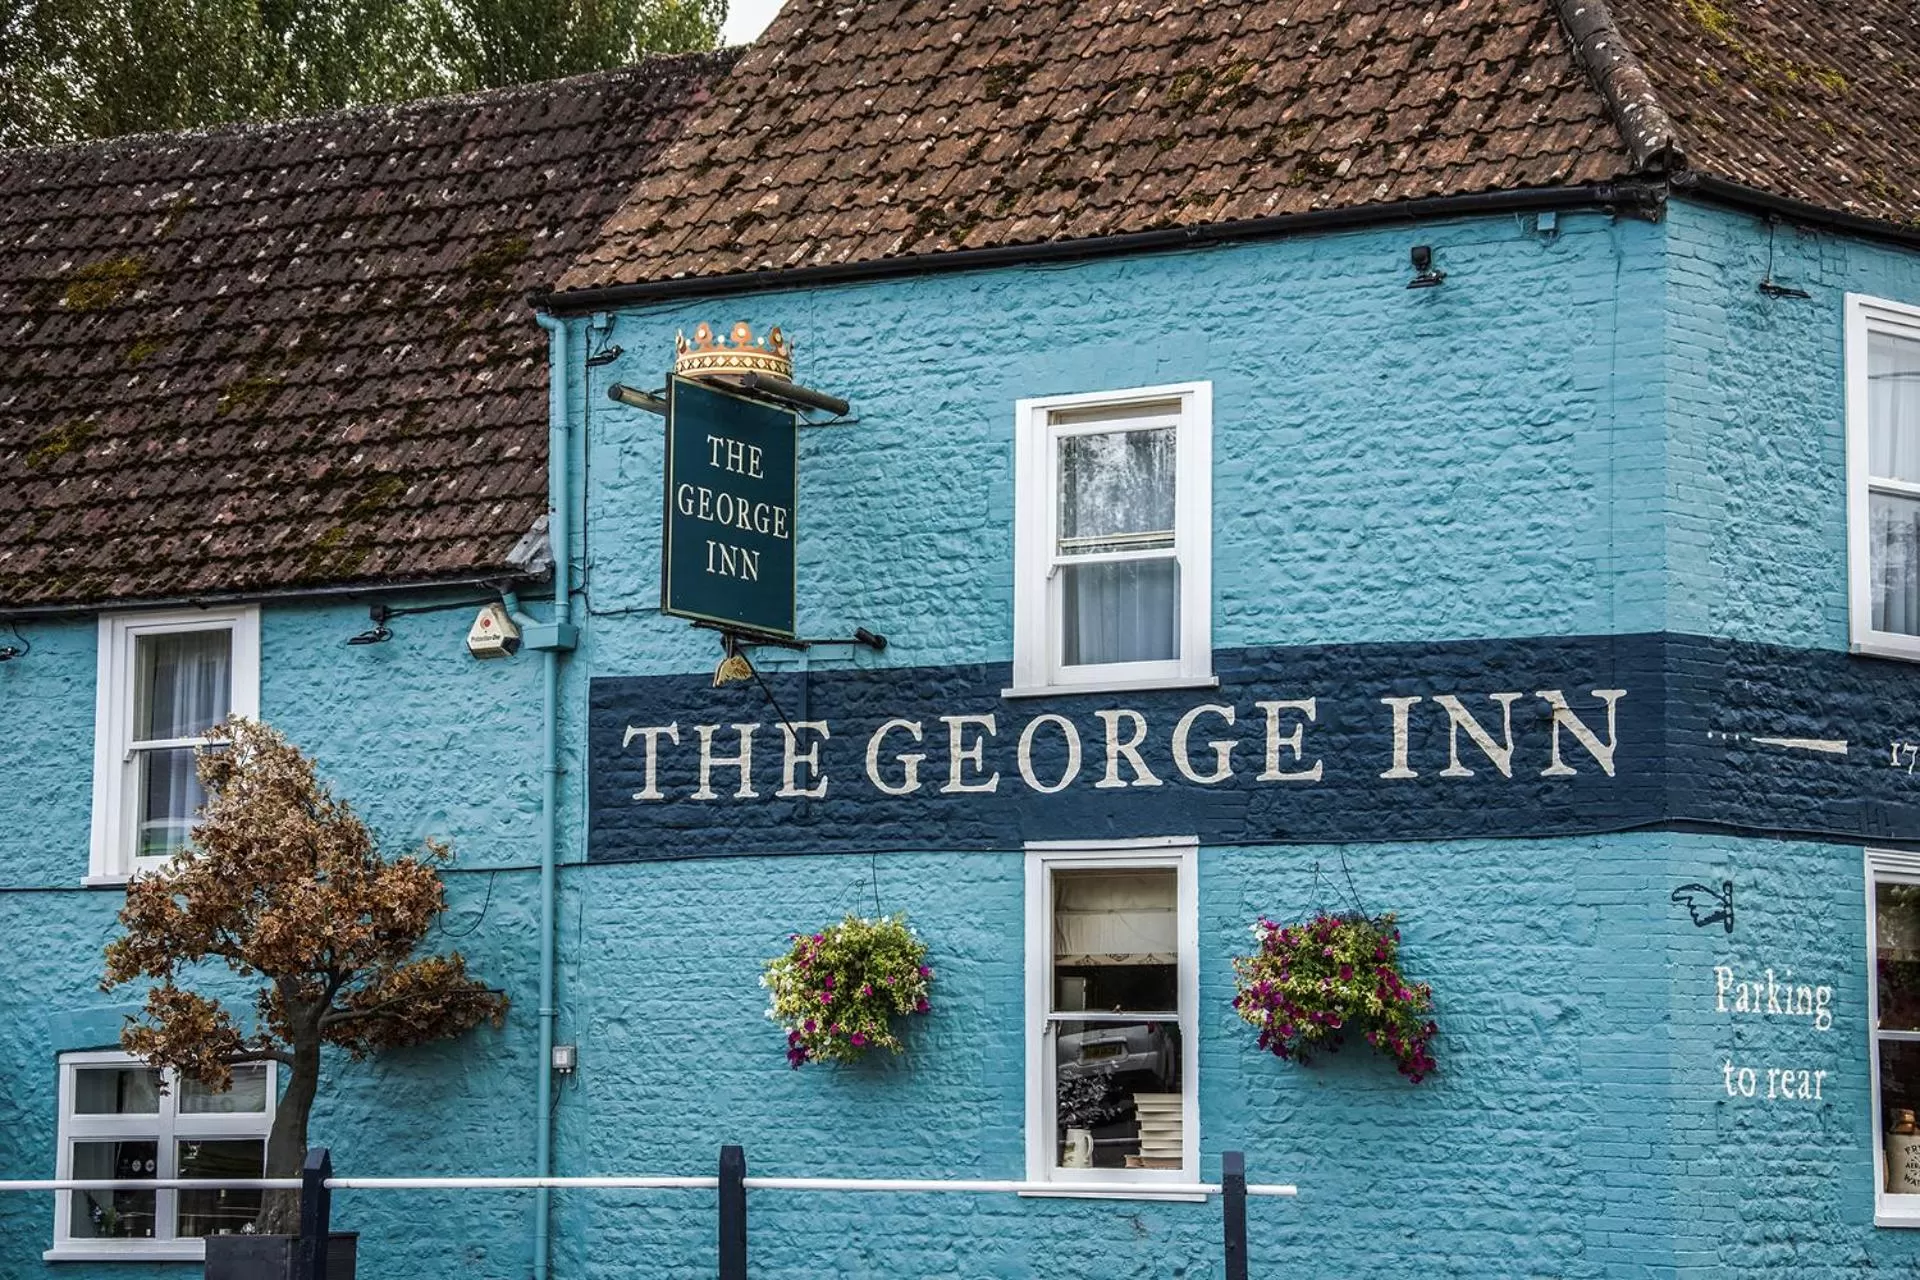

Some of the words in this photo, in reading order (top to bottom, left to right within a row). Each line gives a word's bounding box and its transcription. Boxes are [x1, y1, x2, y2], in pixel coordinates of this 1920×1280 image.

[706, 434, 764, 479] THE
[677, 483, 789, 539] GEORGE
[706, 540, 760, 582] INN
[622, 720, 830, 800] THE
[865, 697, 1323, 795] GEORGE
[1379, 689, 1628, 779] INN
[1713, 966, 1833, 1031] Parking
[1723, 1059, 1756, 1097] to
[1767, 1067, 1827, 1100] rear
